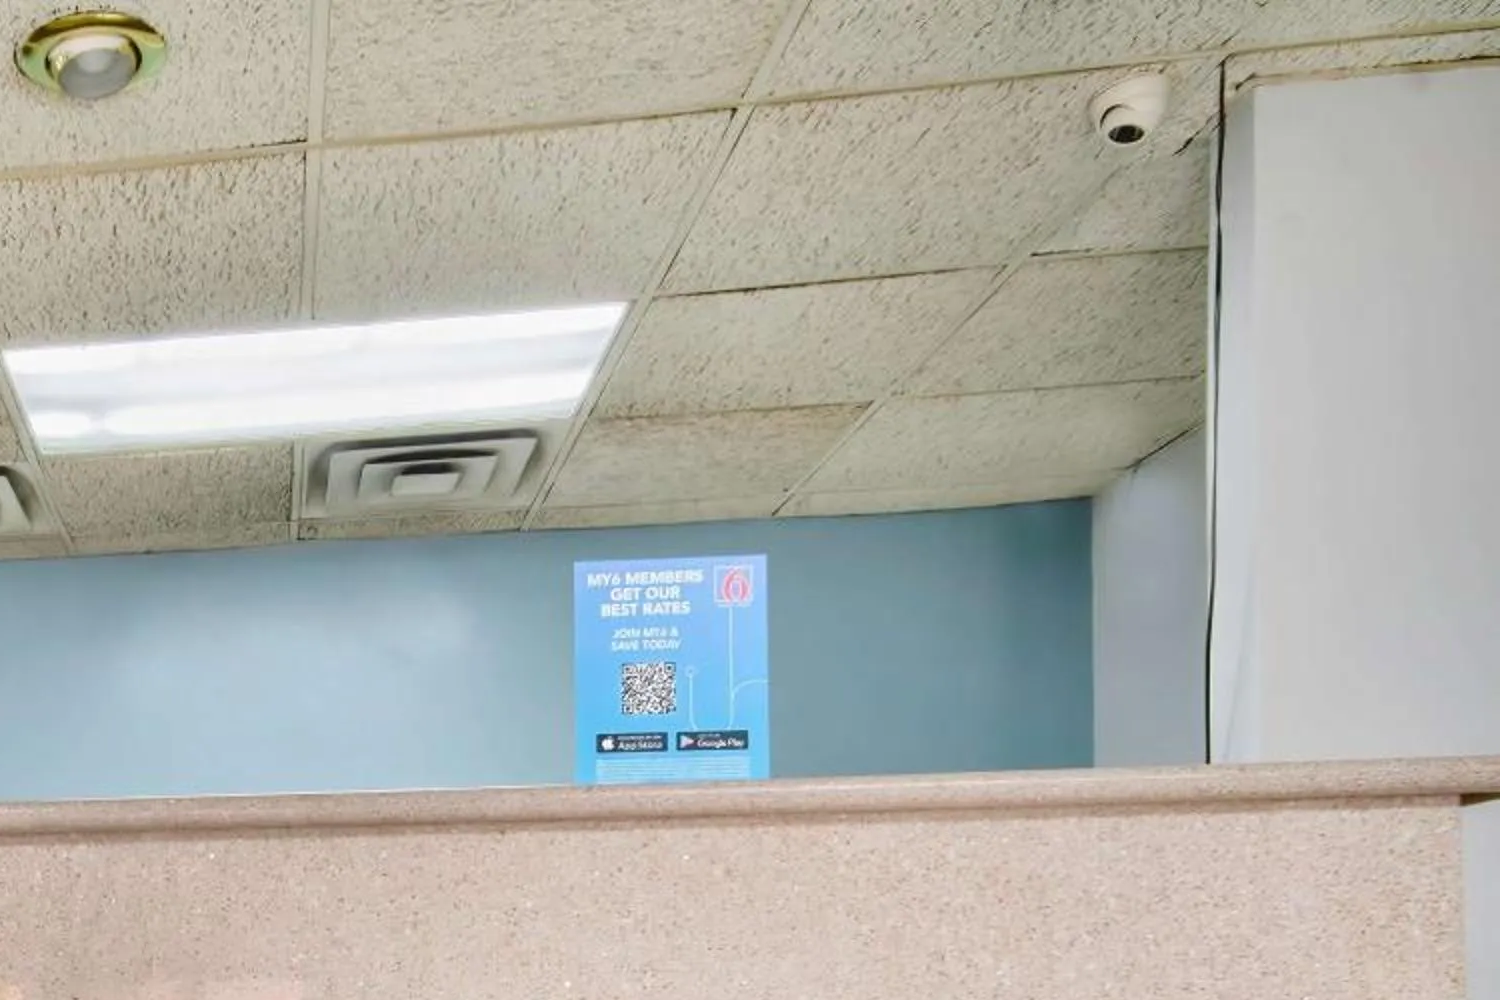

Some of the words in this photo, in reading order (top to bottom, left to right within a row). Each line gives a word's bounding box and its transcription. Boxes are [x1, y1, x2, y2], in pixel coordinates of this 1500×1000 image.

[587, 573, 621, 587] MY6
[625, 569, 704, 585] MEMBERS
[611, 587, 640, 601] GET
[644, 585, 681, 600] OUR
[601, 603, 638, 617] BEST
[642, 601, 691, 615] RATES
[642, 639, 682, 650] TODAY
[697, 739, 726, 749] Google
